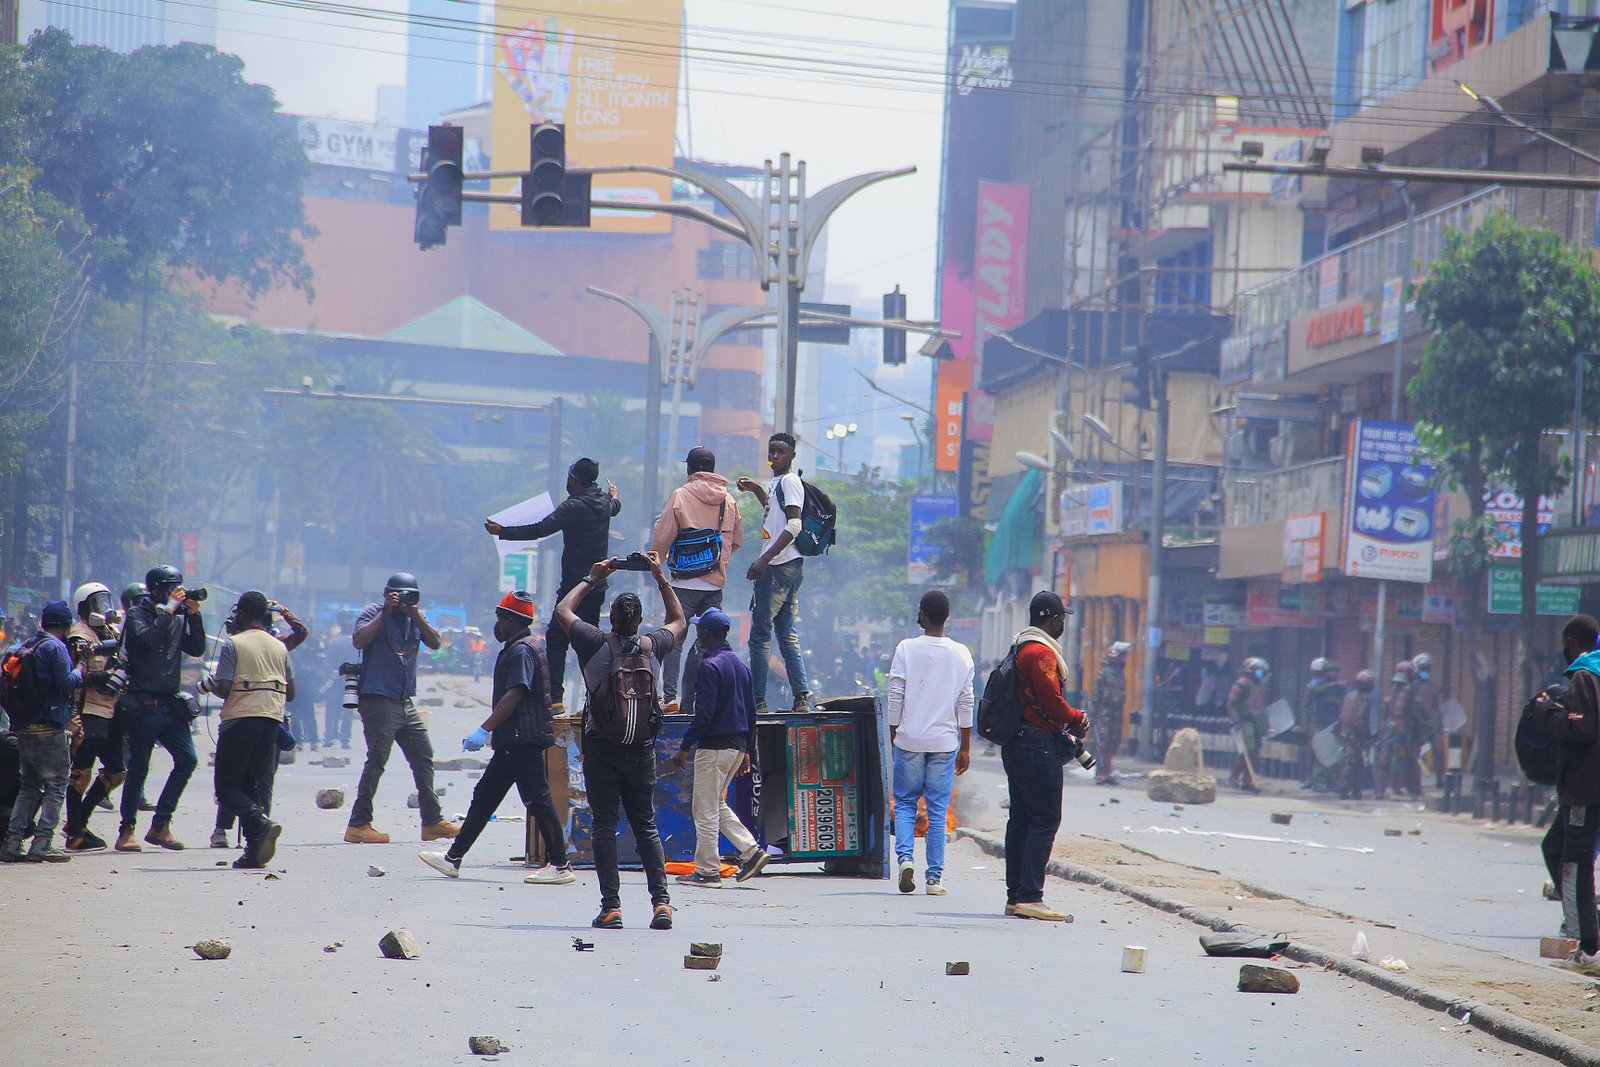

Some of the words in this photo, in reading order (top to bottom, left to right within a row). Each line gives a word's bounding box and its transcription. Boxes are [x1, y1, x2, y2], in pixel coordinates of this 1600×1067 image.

[577, 57, 615, 73] FREE
[577, 73, 650, 91] DELIVERY
[576, 92, 602, 108] ALL
[608, 92, 669, 109] MONTH
[576, 109, 621, 126] LONG
[326, 132, 374, 160] GYM
[1380, 548, 1420, 560] RIKKO
[808, 791, 816, 821] AGENT
[816, 789, 834, 850] 2039603
